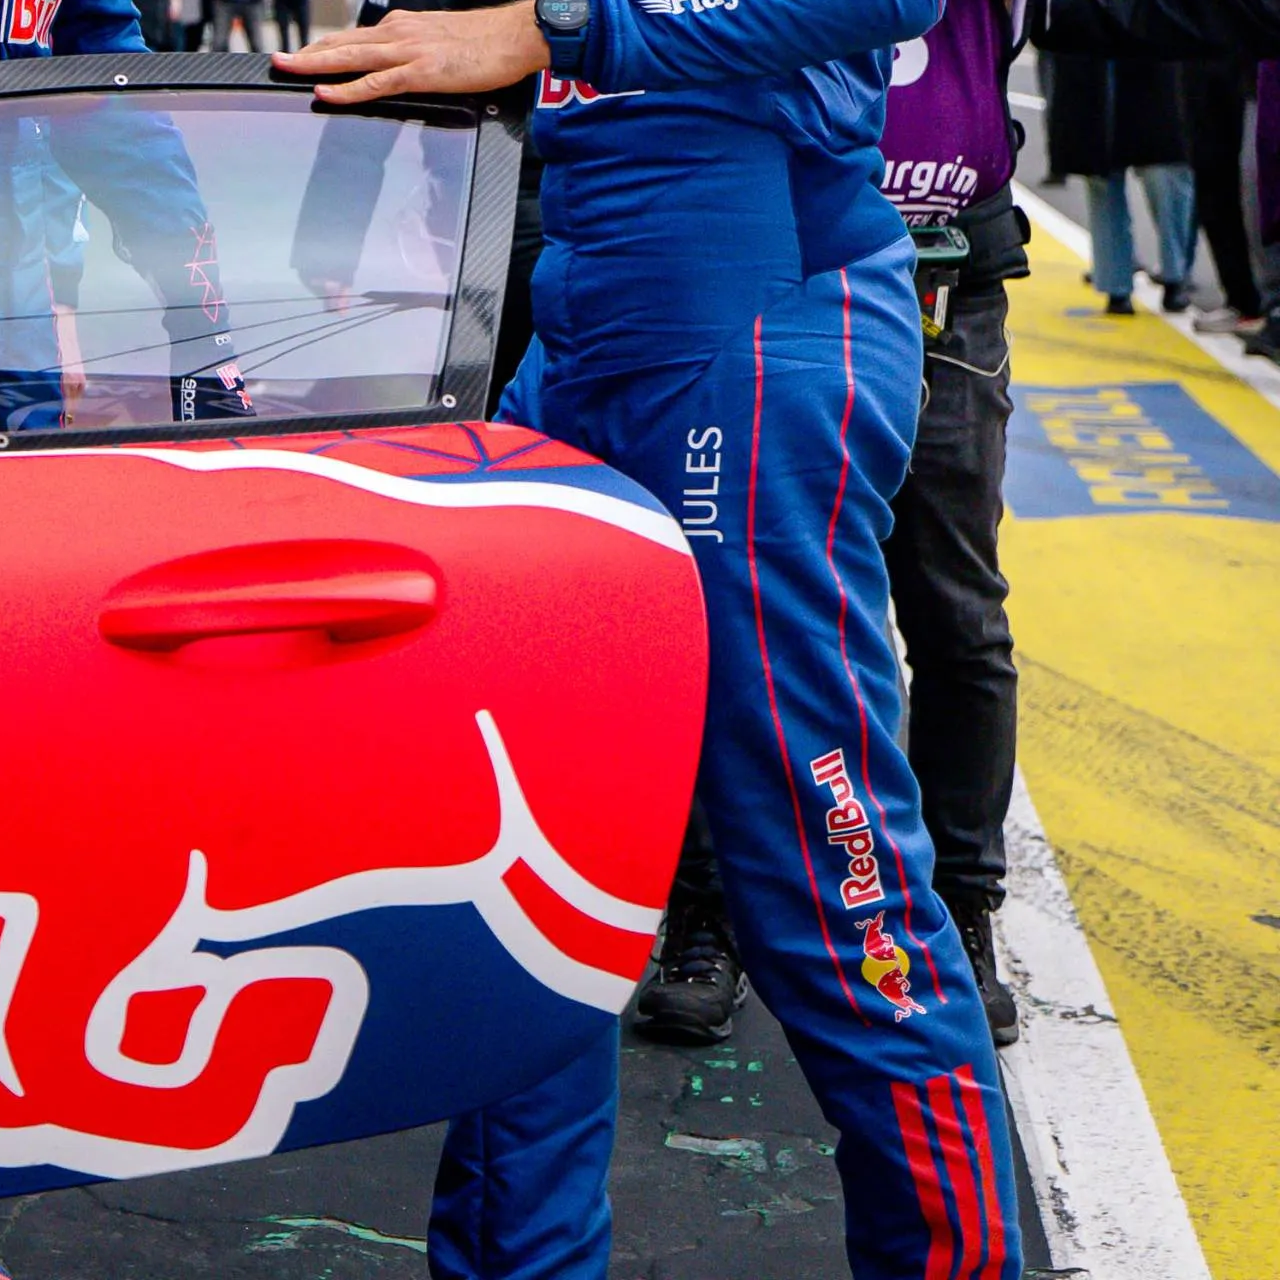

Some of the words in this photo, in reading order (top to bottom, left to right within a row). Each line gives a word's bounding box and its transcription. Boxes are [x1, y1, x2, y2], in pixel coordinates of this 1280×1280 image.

[683, 425, 724, 543] JULES
[810, 747, 870, 834] Bull
[827, 828, 886, 910] Red
